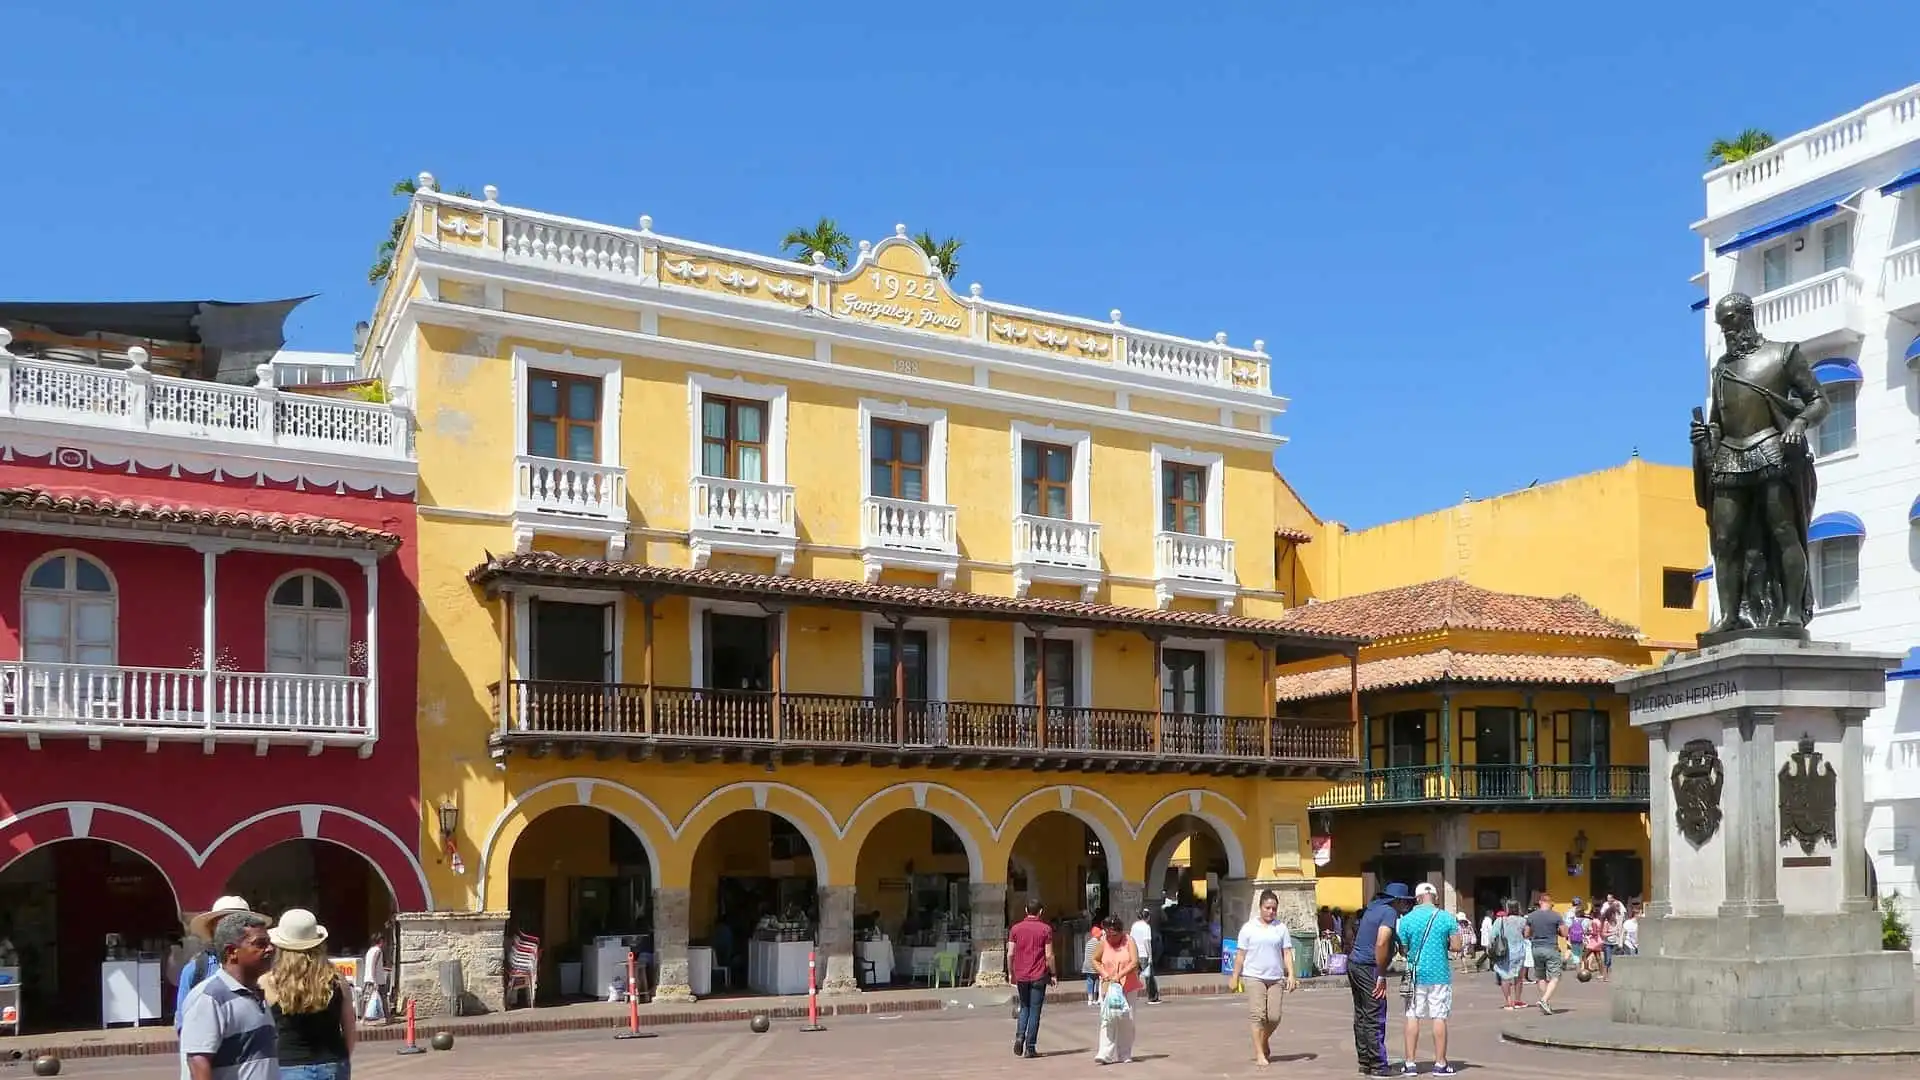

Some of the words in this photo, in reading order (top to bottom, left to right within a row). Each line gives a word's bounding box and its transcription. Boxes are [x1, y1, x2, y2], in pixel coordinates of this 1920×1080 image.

[871, 271, 939, 303] 1922
[916, 308, 961, 328] Porto
[1633, 694, 1674, 714] PEDRO
[1686, 680, 1739, 705] HEREDIA
